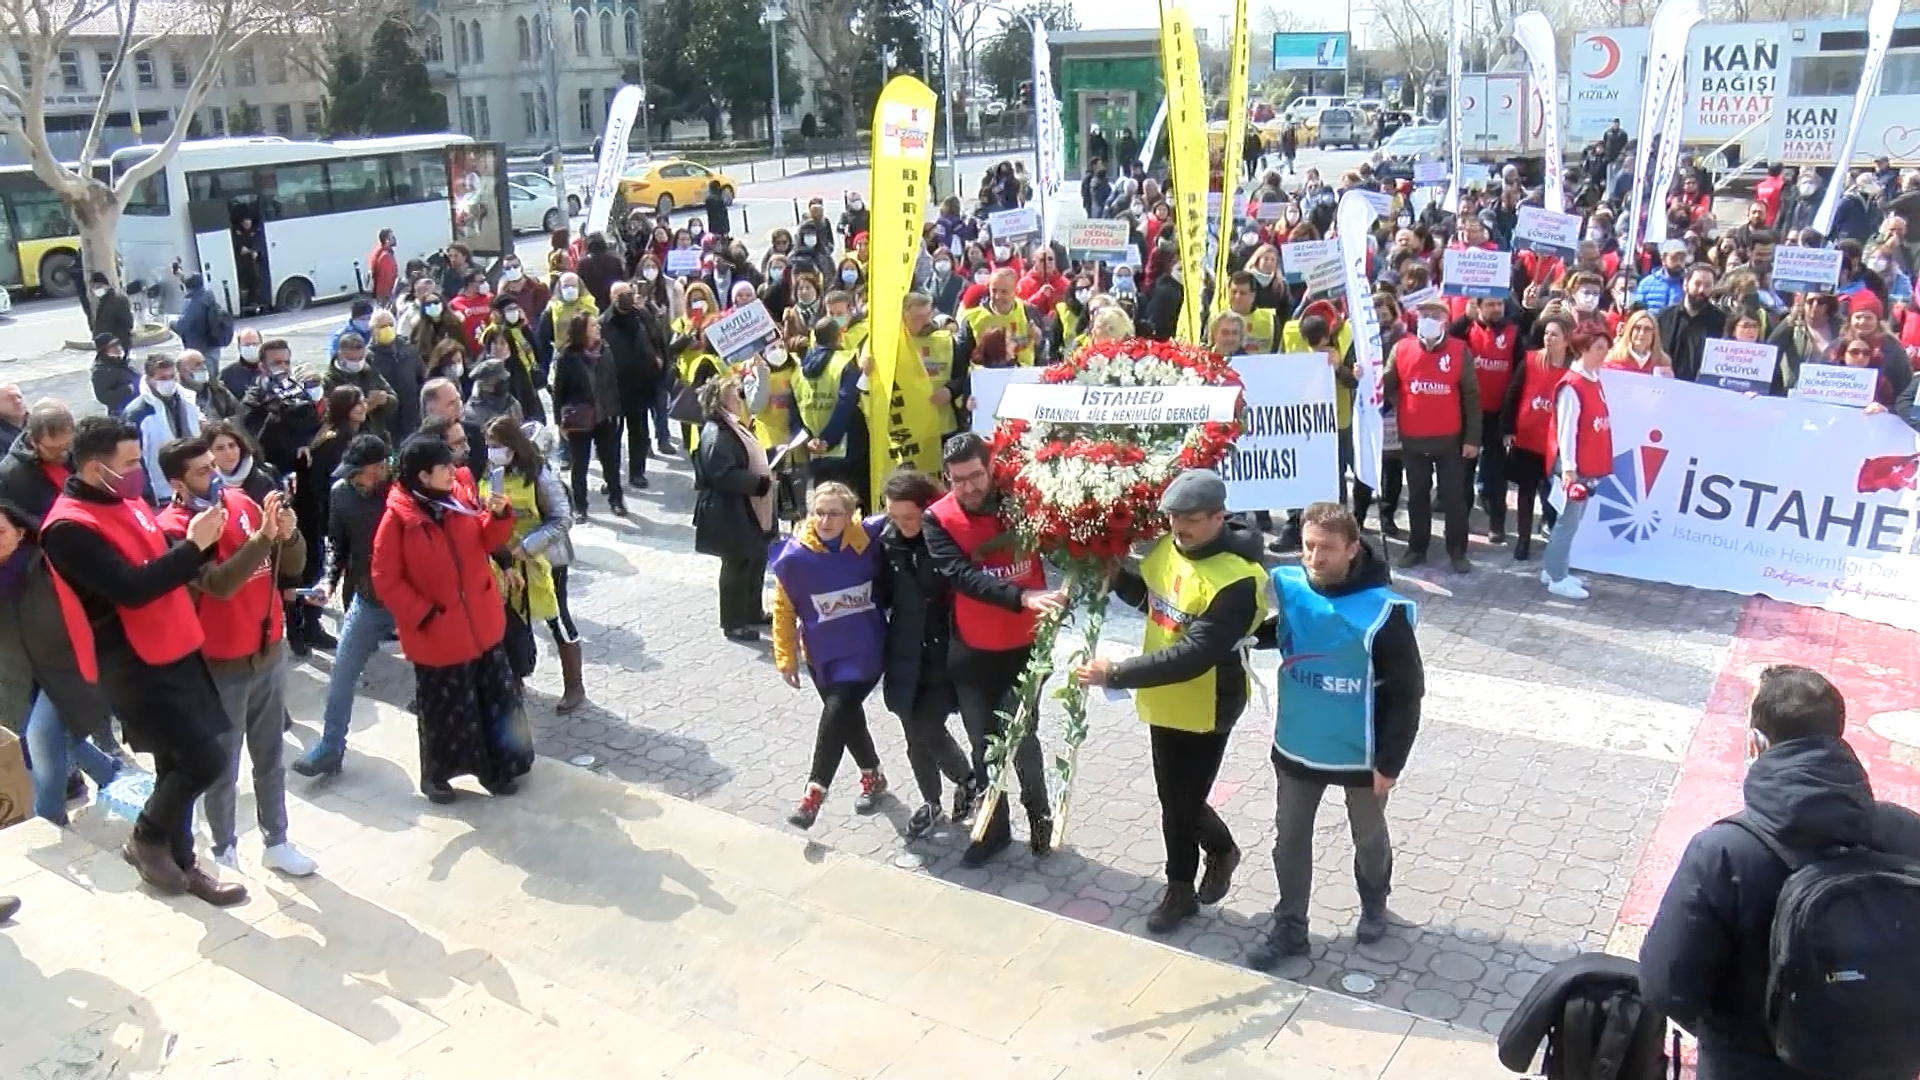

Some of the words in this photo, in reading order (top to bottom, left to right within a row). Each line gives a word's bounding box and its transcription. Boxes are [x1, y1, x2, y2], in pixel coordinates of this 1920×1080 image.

[1703, 44, 1778, 71] KAN
[1702, 74, 1775, 95] BAĞIŞI
[1578, 90, 1619, 100] KIZILAY
[1700, 96, 1774, 111] HAYAT
[1700, 114, 1765, 125] KURTAR
[1787, 108, 1837, 125] KAN
[1785, 127, 1835, 141] BAĞIŞI
[1784, 142, 1832, 151] HAYAT
[720, 310, 752, 332] MUTLU
[1082, 386, 1164, 406] İSTAHED
[1034, 404, 1080, 421] İSTANBUL
[1086, 407, 1107, 421] AİLE
[1166, 404, 1210, 421] DERNEĞİ
[1246, 402, 1336, 441] DAYANIŞMA
[1678, 457, 1920, 556] İSTAHE
